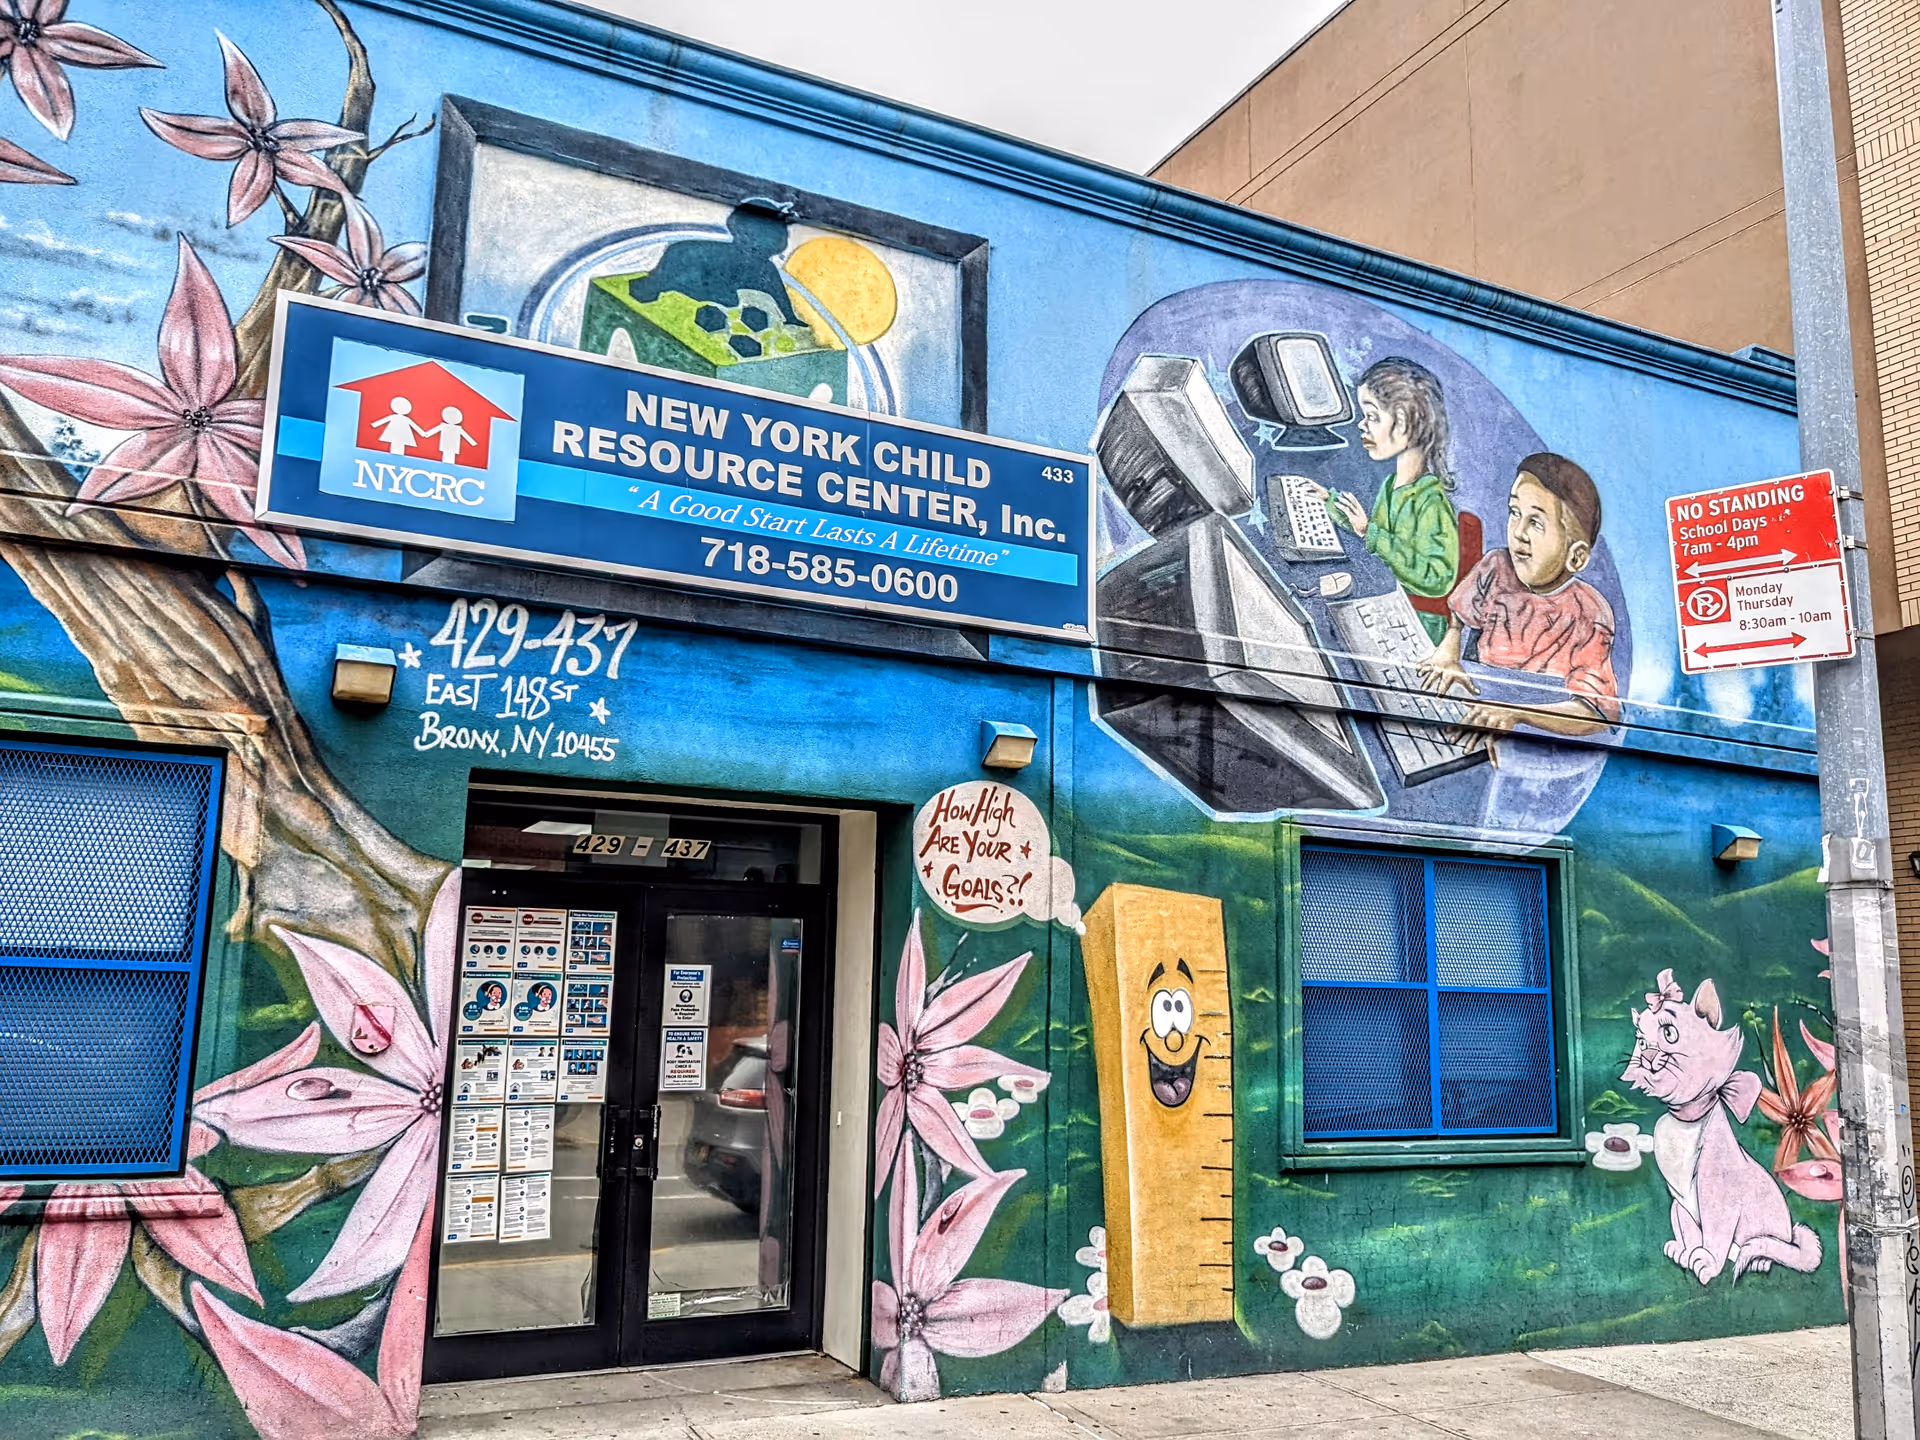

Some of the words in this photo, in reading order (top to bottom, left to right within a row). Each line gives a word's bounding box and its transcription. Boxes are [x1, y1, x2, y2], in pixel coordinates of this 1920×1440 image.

[626, 389, 729, 440] NEW
[741, 413, 861, 467] YORK
[873, 441, 991, 489] CHILD
[352, 458, 485, 506] NYCRC
[552, 420, 802, 497] RESOURCE
[817, 471, 988, 535] CENTER,
[1001, 504, 1067, 543] Inc.
[1041, 465, 1074, 485] 433
[668, 494, 739, 525] Good
[748, 507, 808, 536] Start
[808, 518, 877, 547] Lasts
[878, 531, 899, 550] A
[1676, 503, 1703, 522] NO
[1709, 484, 1805, 516] STANDING
[1679, 520, 1728, 541] School
[1732, 515, 1768, 533] Days
[1681, 542, 1712, 557] 7am
[1727, 534, 1759, 551] 4pm
[700, 537, 958, 603] 718-585-0600
[1735, 582, 1783, 598] Monday
[1737, 595, 1794, 612] Thursday
[429, 598, 638, 679] 429-437
[1739, 614, 1787, 631] 8:30am
[1799, 610, 1832, 624] 10am
[425, 673, 498, 711] EAST
[413, 711, 506, 758] BRONX,
[511, 723, 554, 758] NY
[551, 730, 619, 762] 10455
[928, 789, 975, 828] How
[970, 786, 1016, 837] High
[575, 835, 621, 854] 429
[664, 840, 710, 858] 437
[919, 825, 960, 858] ARE
[962, 830, 1012, 863] YOUR
